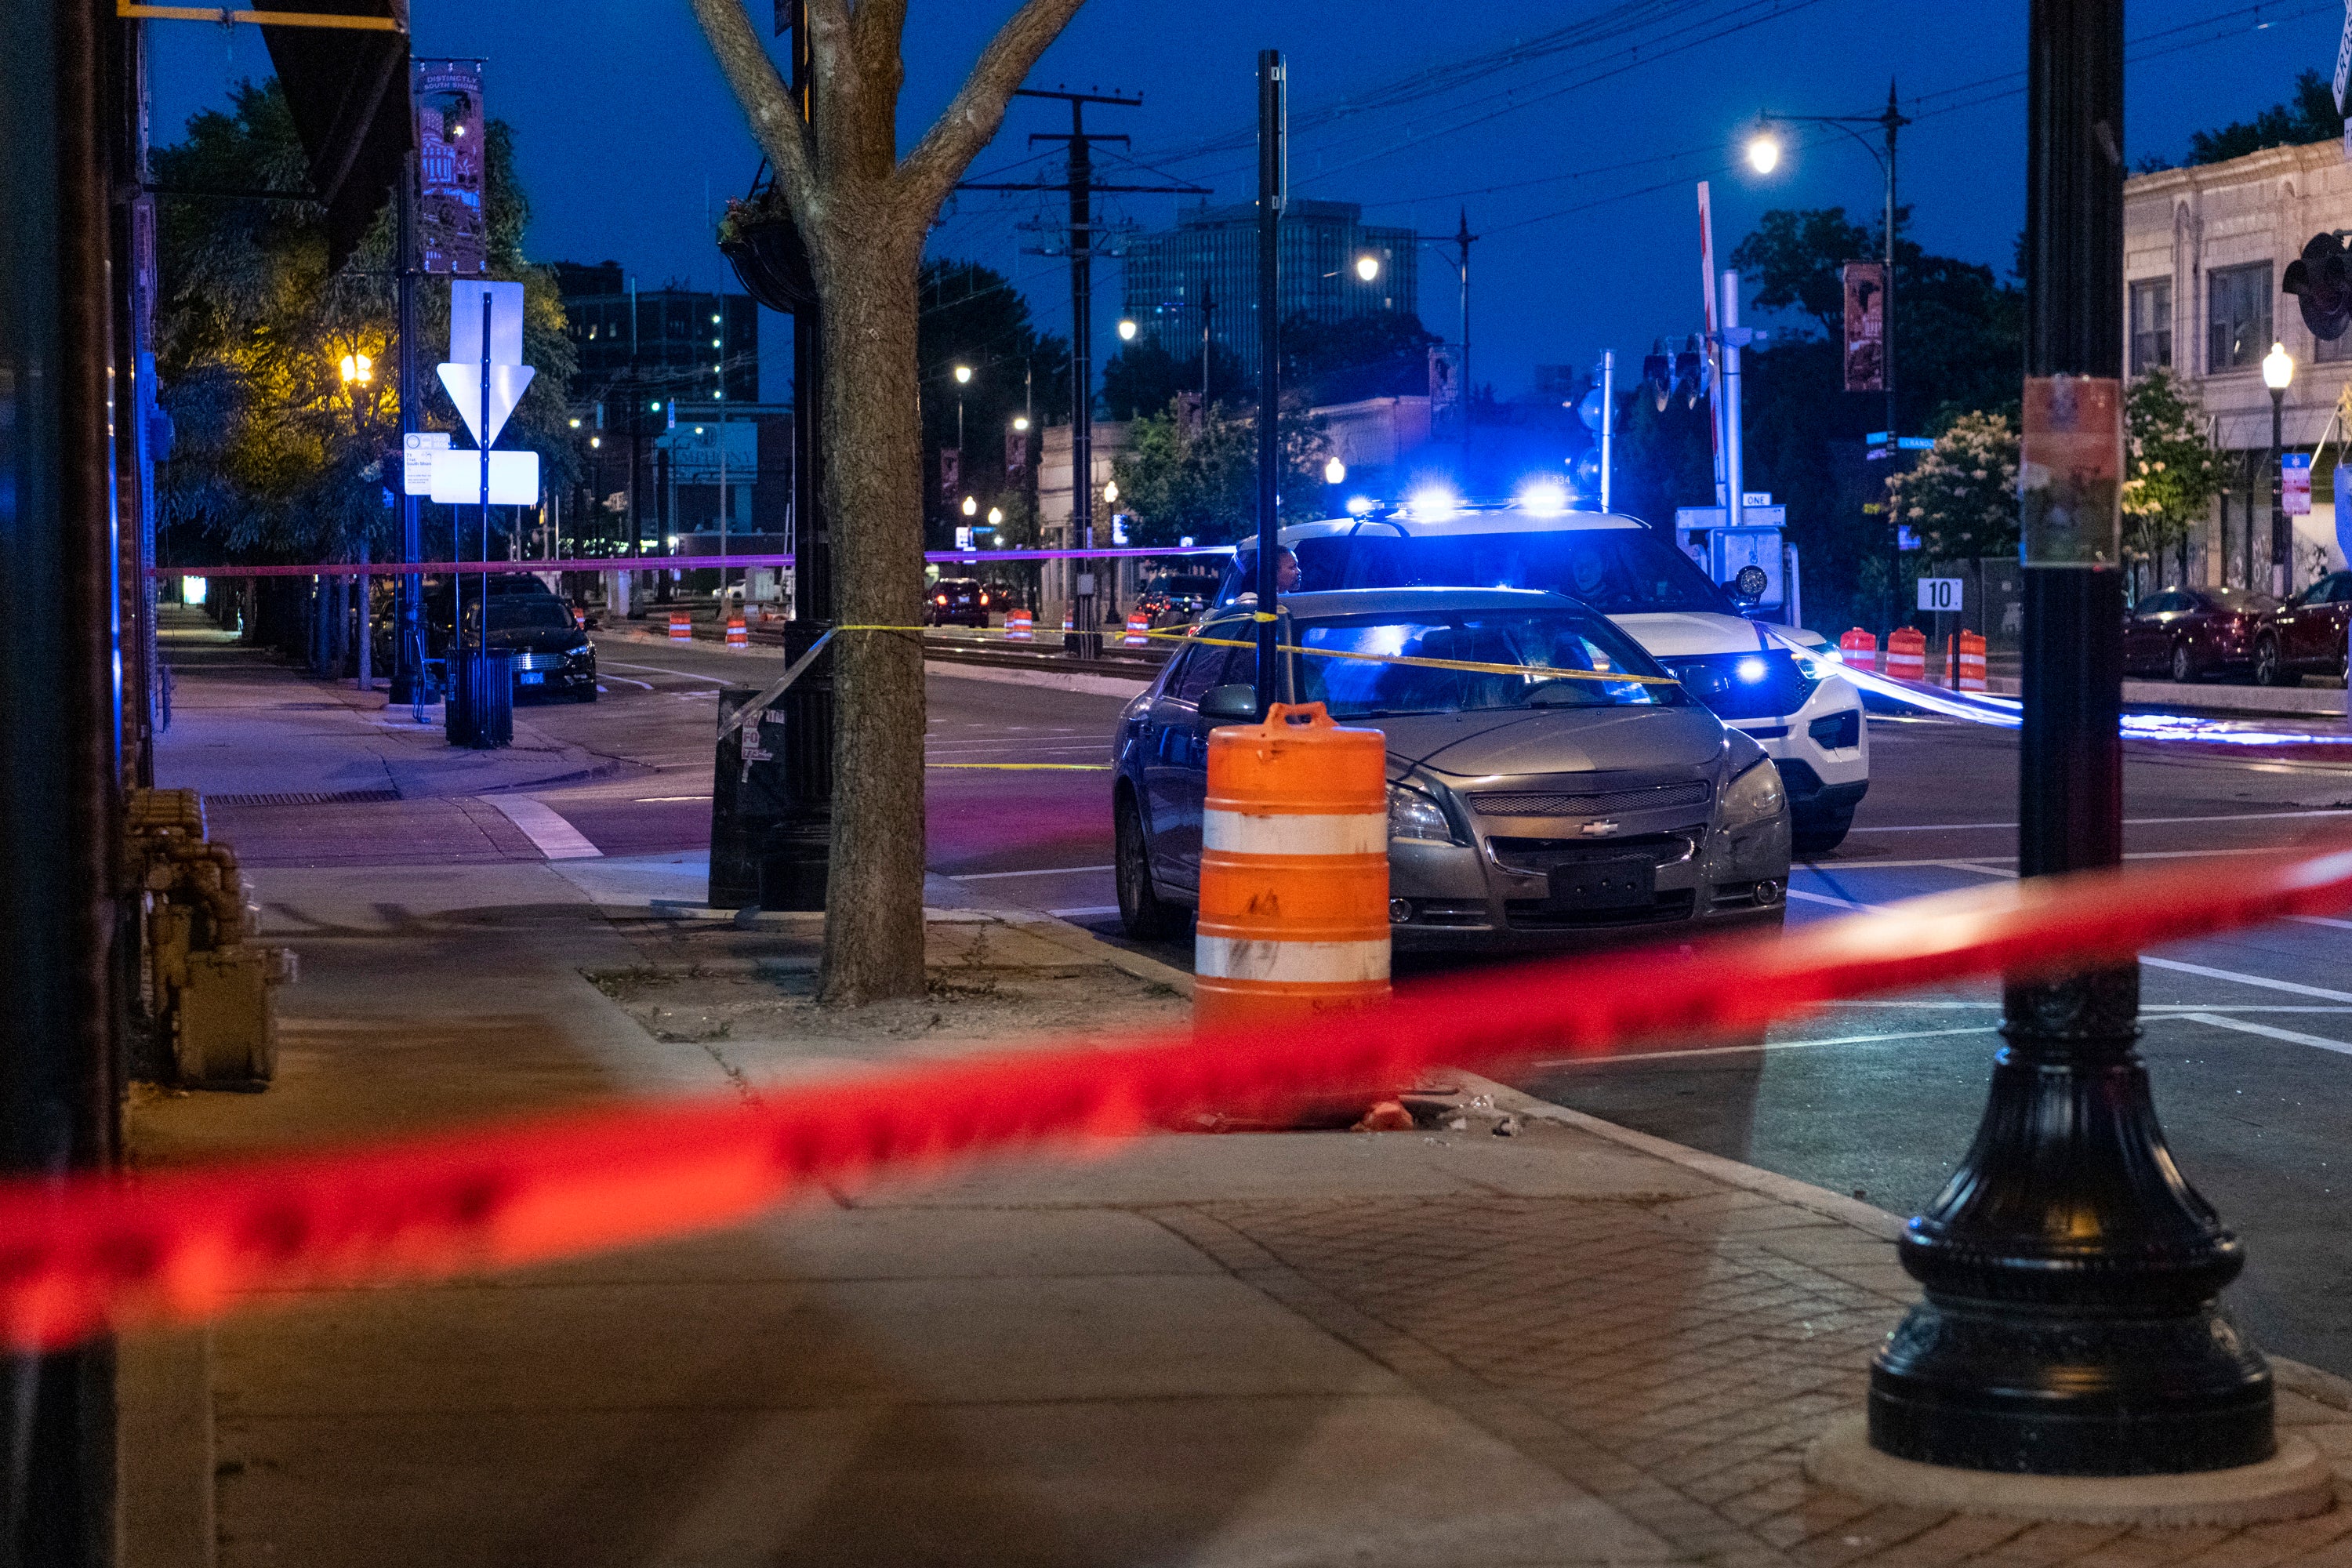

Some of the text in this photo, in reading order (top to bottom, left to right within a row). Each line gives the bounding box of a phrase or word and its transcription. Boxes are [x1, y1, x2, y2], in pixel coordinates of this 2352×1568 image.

[427, 74, 477, 83] DISTINCTLY
[452, 82, 478, 91] SHORE
[1748, 496, 1765, 505] ONE
[1929, 581, 1951, 608] 10
